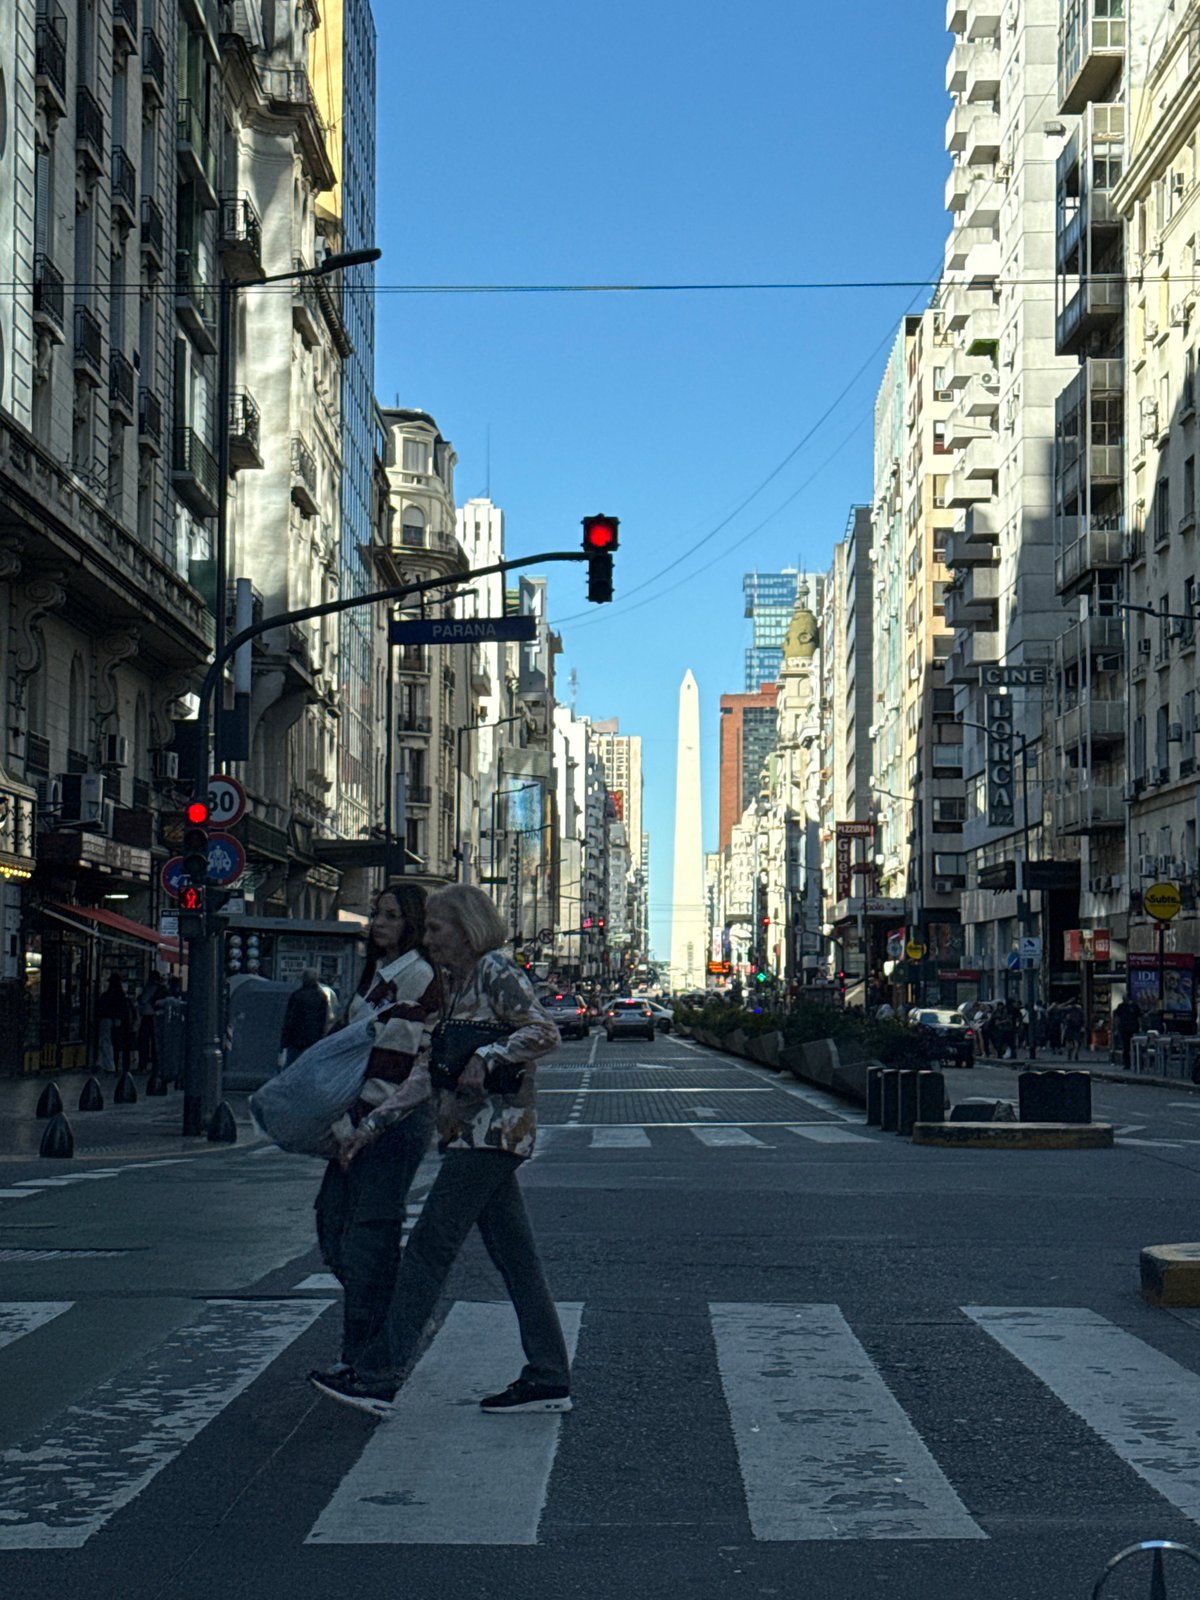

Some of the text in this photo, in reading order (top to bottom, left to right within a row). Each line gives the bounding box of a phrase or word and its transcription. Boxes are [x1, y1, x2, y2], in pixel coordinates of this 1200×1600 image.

[432, 623, 497, 638] PARANA
[986, 669, 1044, 684] CINE
[990, 699, 1013, 807] LORCA
[838, 824, 870, 834] PIZZERIA
[1150, 894, 1177, 904] Subte
